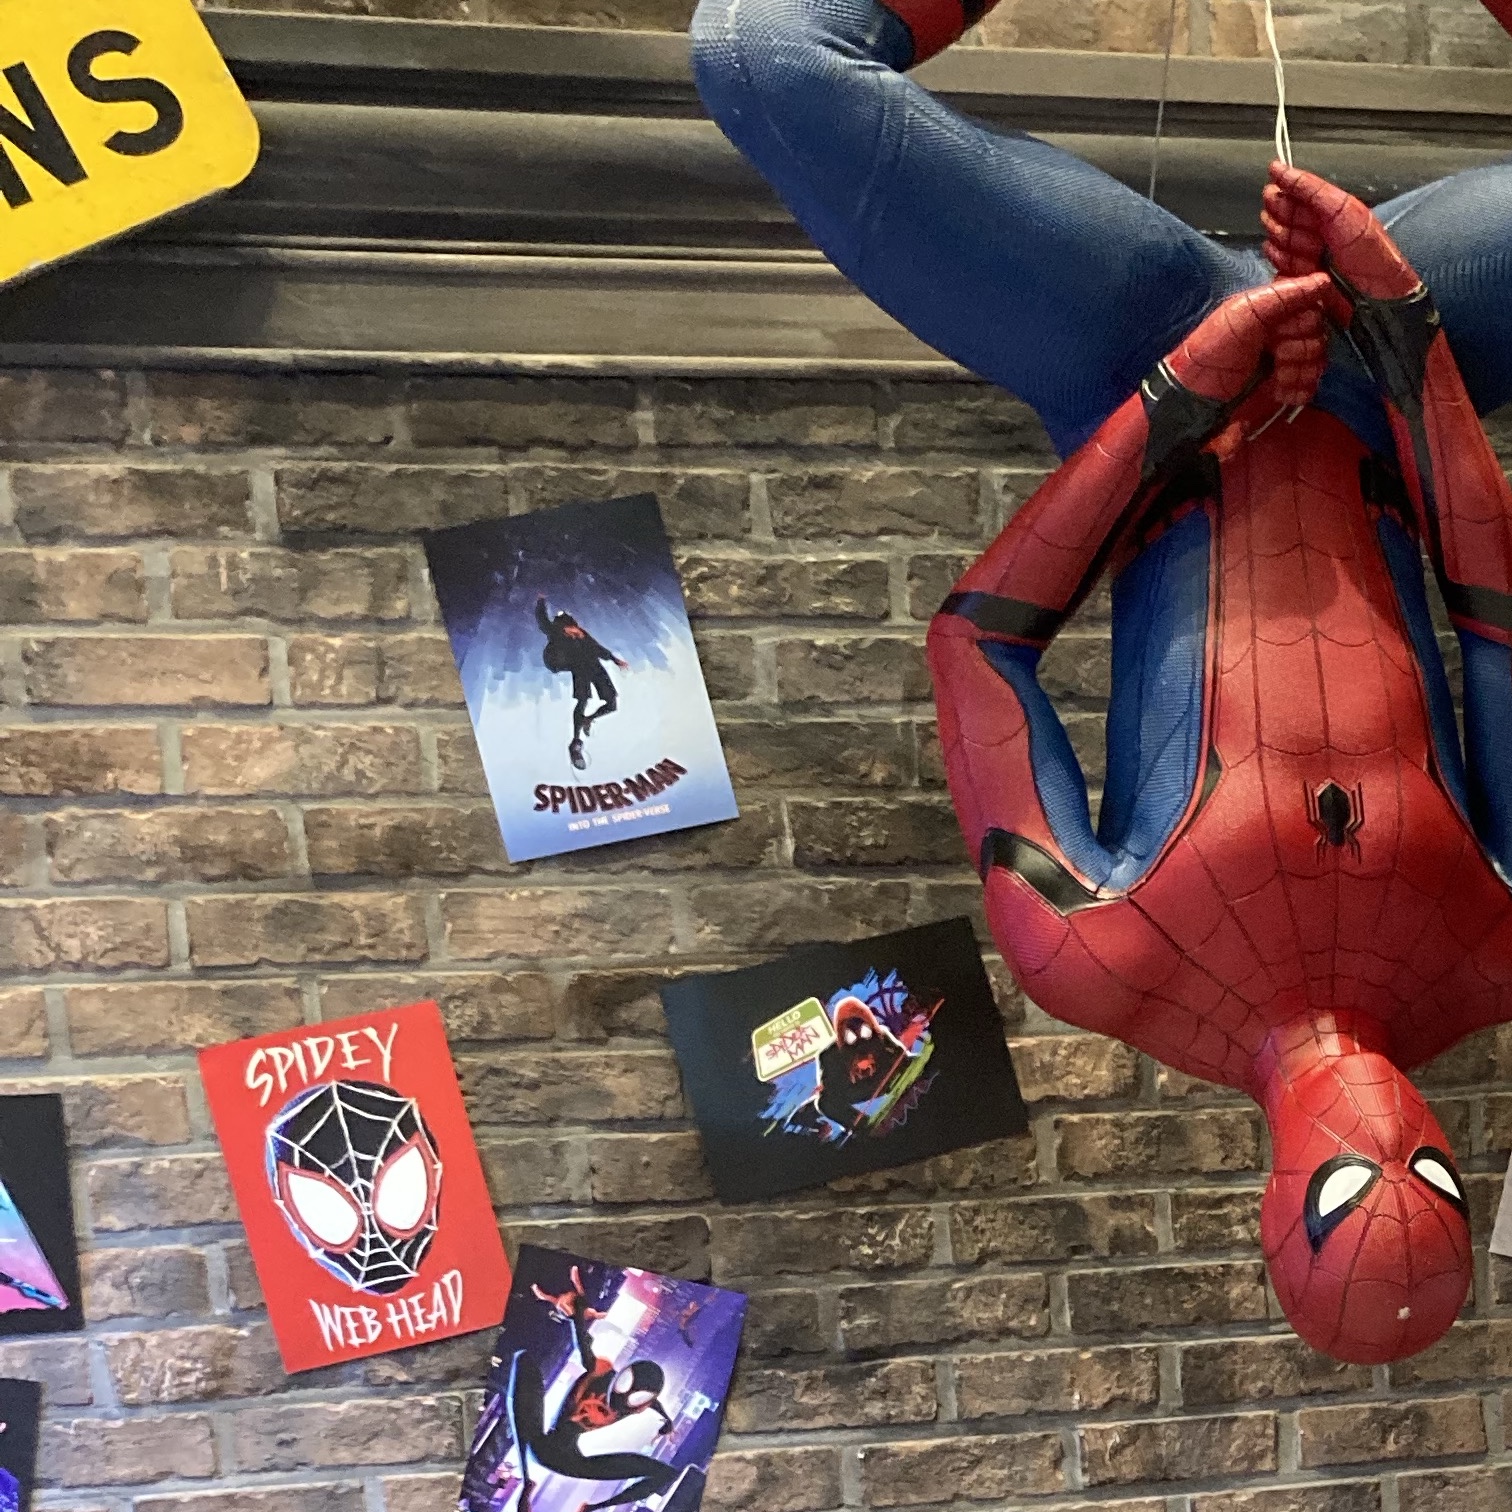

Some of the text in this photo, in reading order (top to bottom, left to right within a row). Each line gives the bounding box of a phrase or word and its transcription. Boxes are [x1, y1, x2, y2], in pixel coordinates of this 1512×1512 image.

[533, 757, 688, 814] SPIDER-MAN
[767, 1010, 801, 1035] HELLO
[245, 1022, 399, 1108] SPIDEY
[308, 1269, 463, 1352] WEB HEAD
